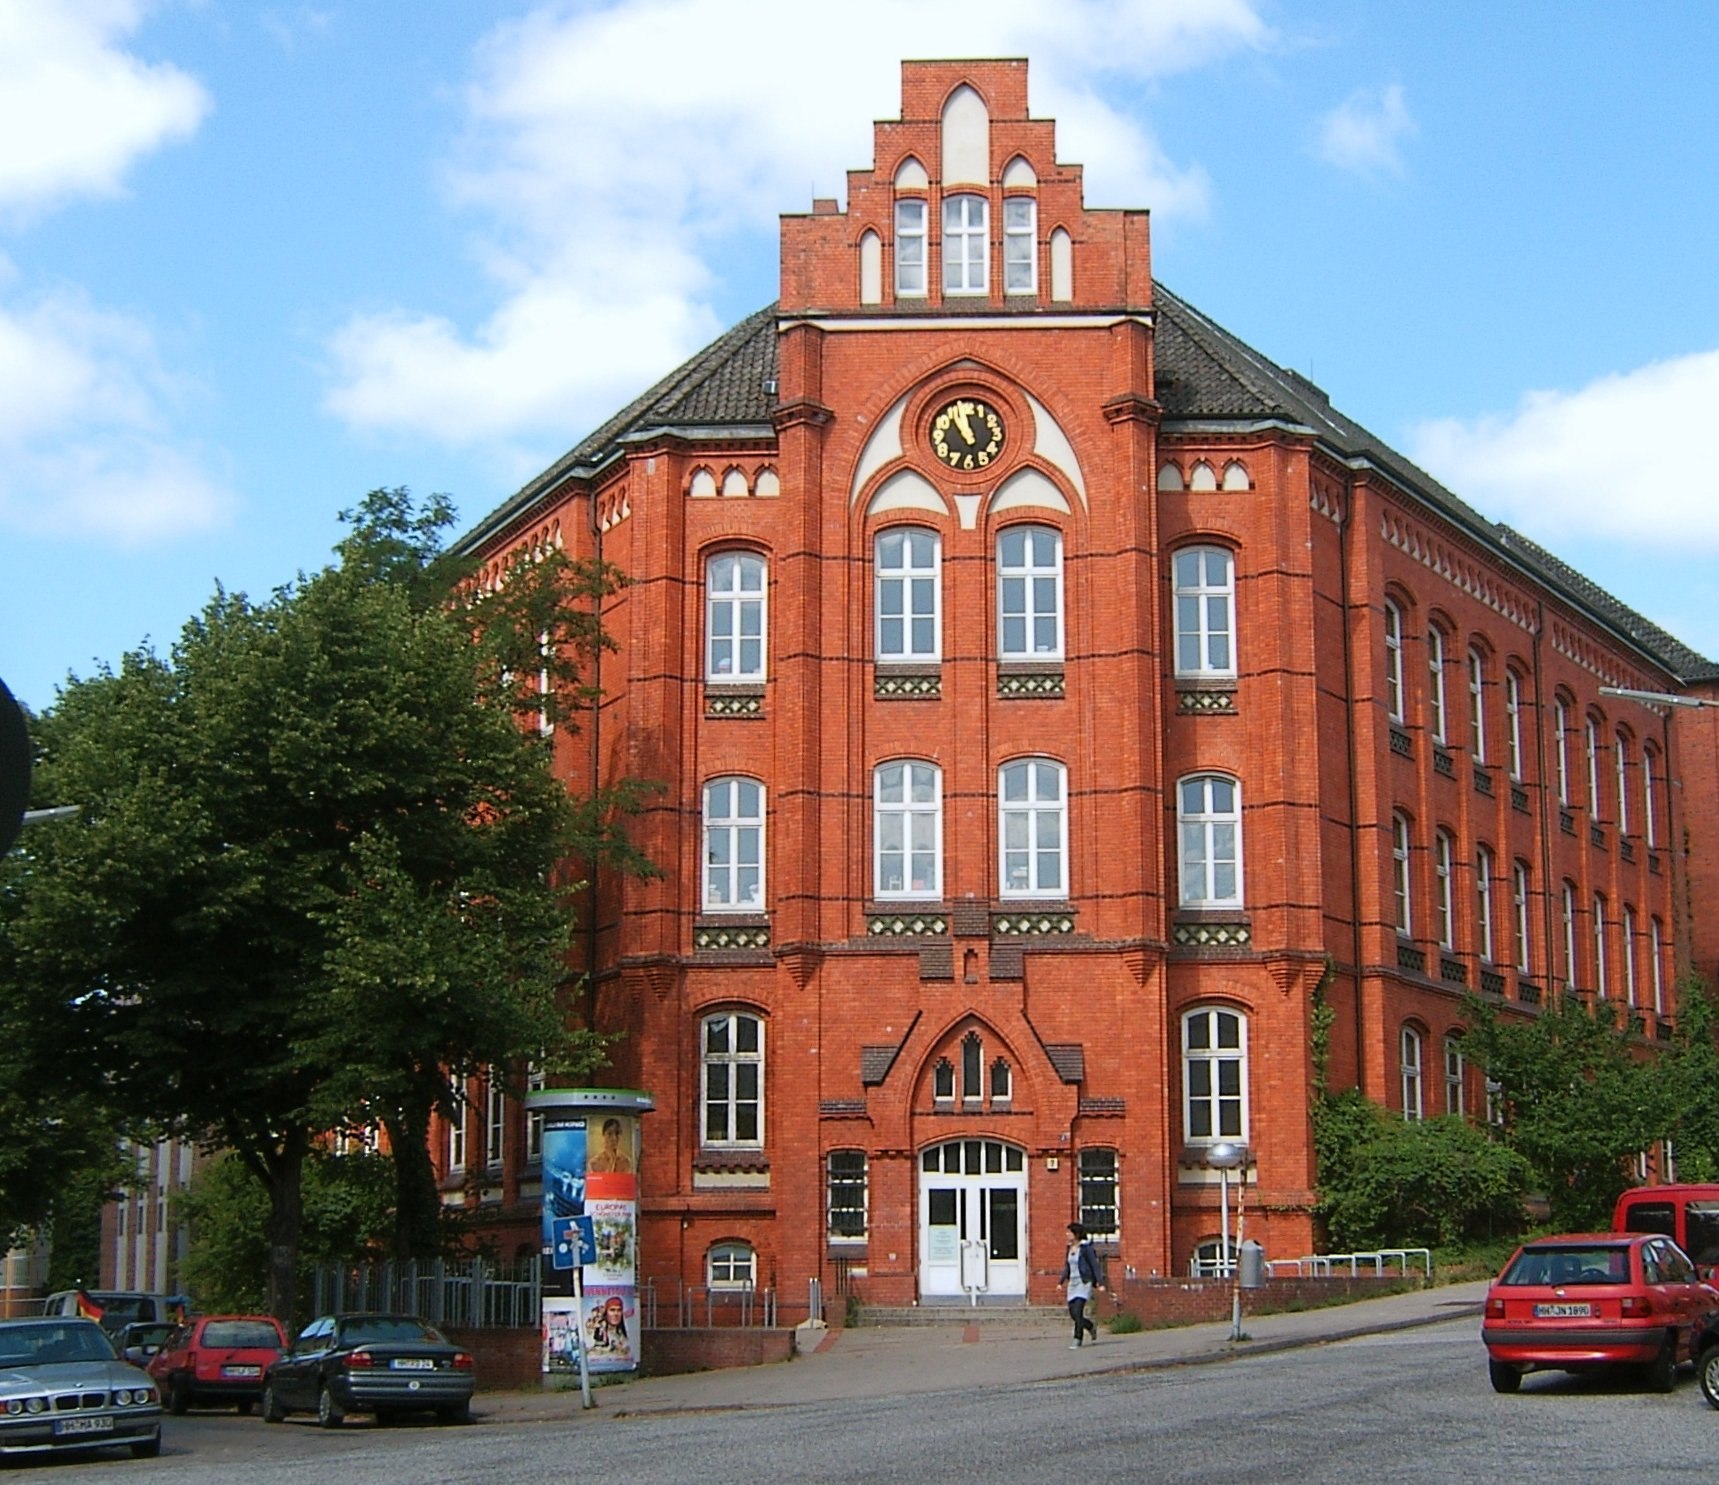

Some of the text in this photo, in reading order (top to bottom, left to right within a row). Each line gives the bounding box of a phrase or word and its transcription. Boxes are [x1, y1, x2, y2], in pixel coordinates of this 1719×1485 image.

[977, 404, 984, 418] 1
[936, 414, 950, 430] 10
[986, 414, 998, 428] 2
[933, 429, 945, 445] 9
[991, 427, 1002, 441] 3
[937, 442, 948, 458] 8
[986, 441, 998, 455] 4
[949, 452, 961, 466] 7
[963, 454, 974, 470] 6
[978, 451, 989, 466] 5
